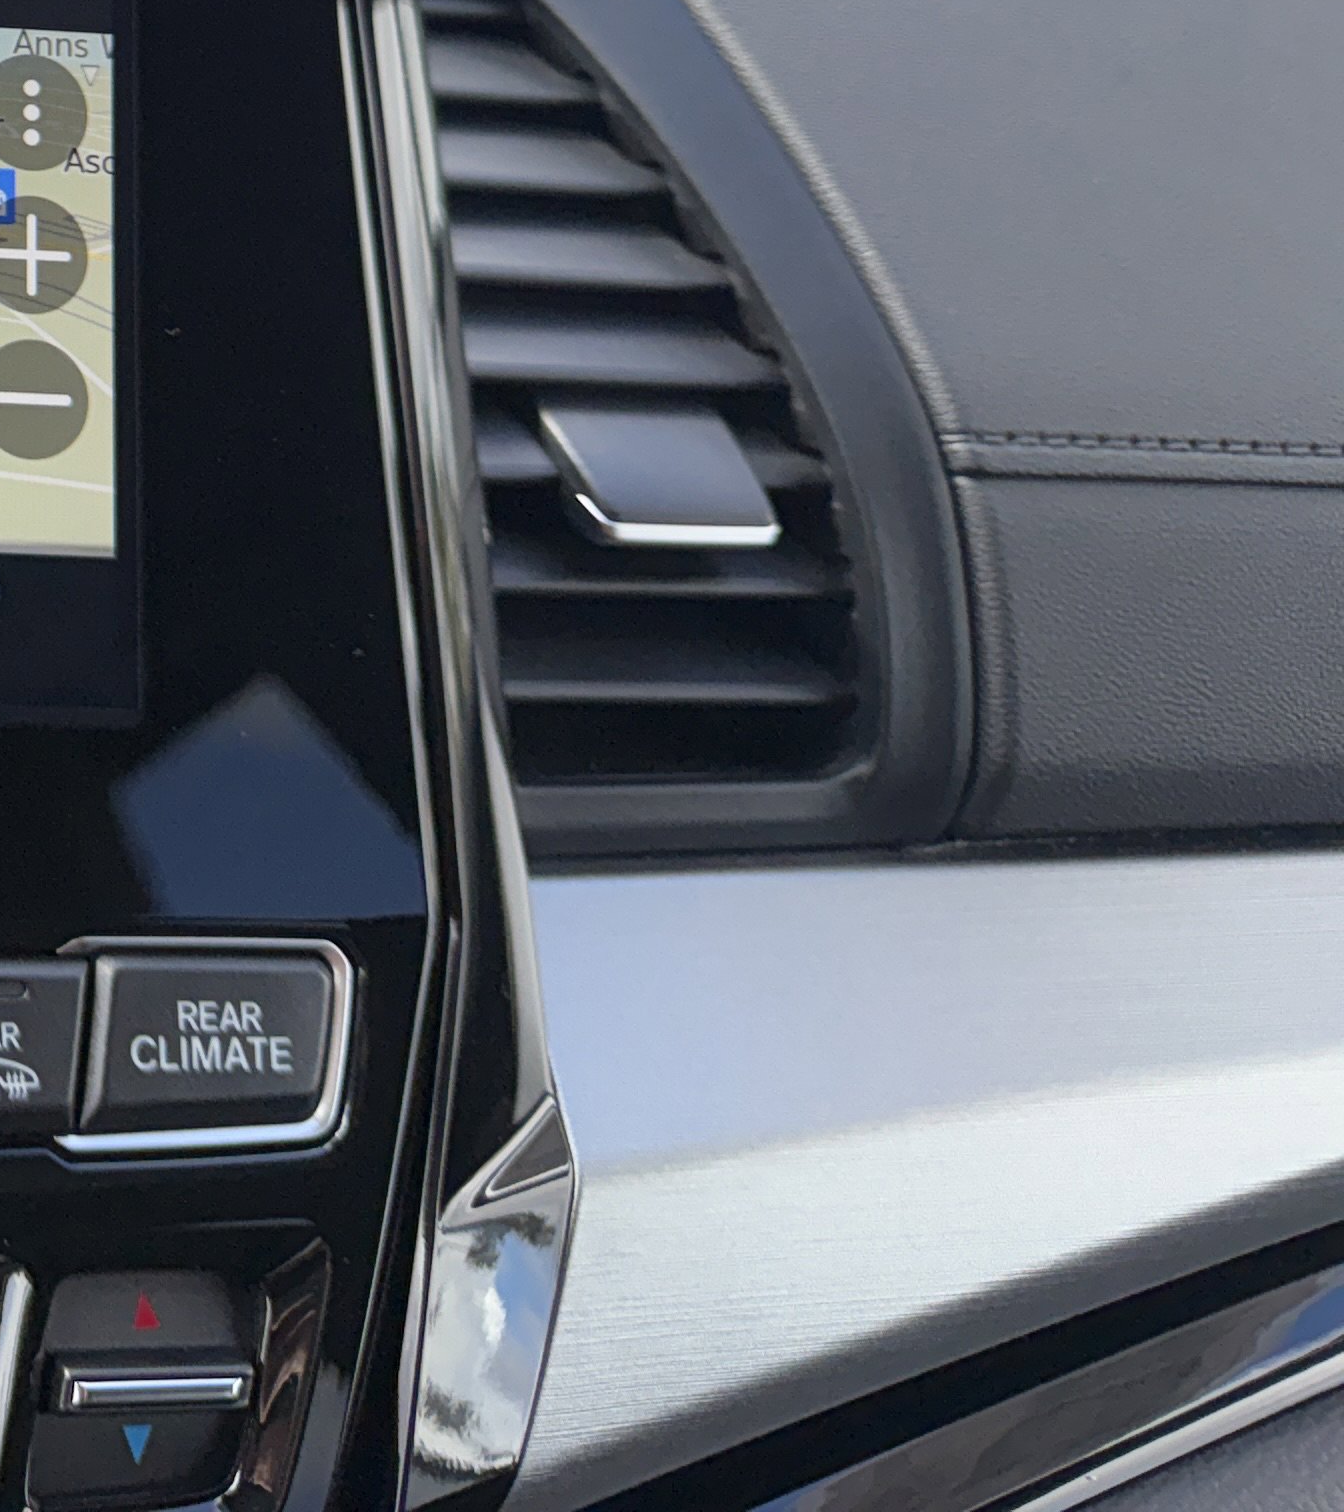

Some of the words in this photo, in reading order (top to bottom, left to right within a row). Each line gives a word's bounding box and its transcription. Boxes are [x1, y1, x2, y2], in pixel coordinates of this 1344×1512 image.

[13, 28, 89, 58] Anns
[176, 1000, 262, 1033] REAR
[128, 1034, 293, 1074] CLIMATE
